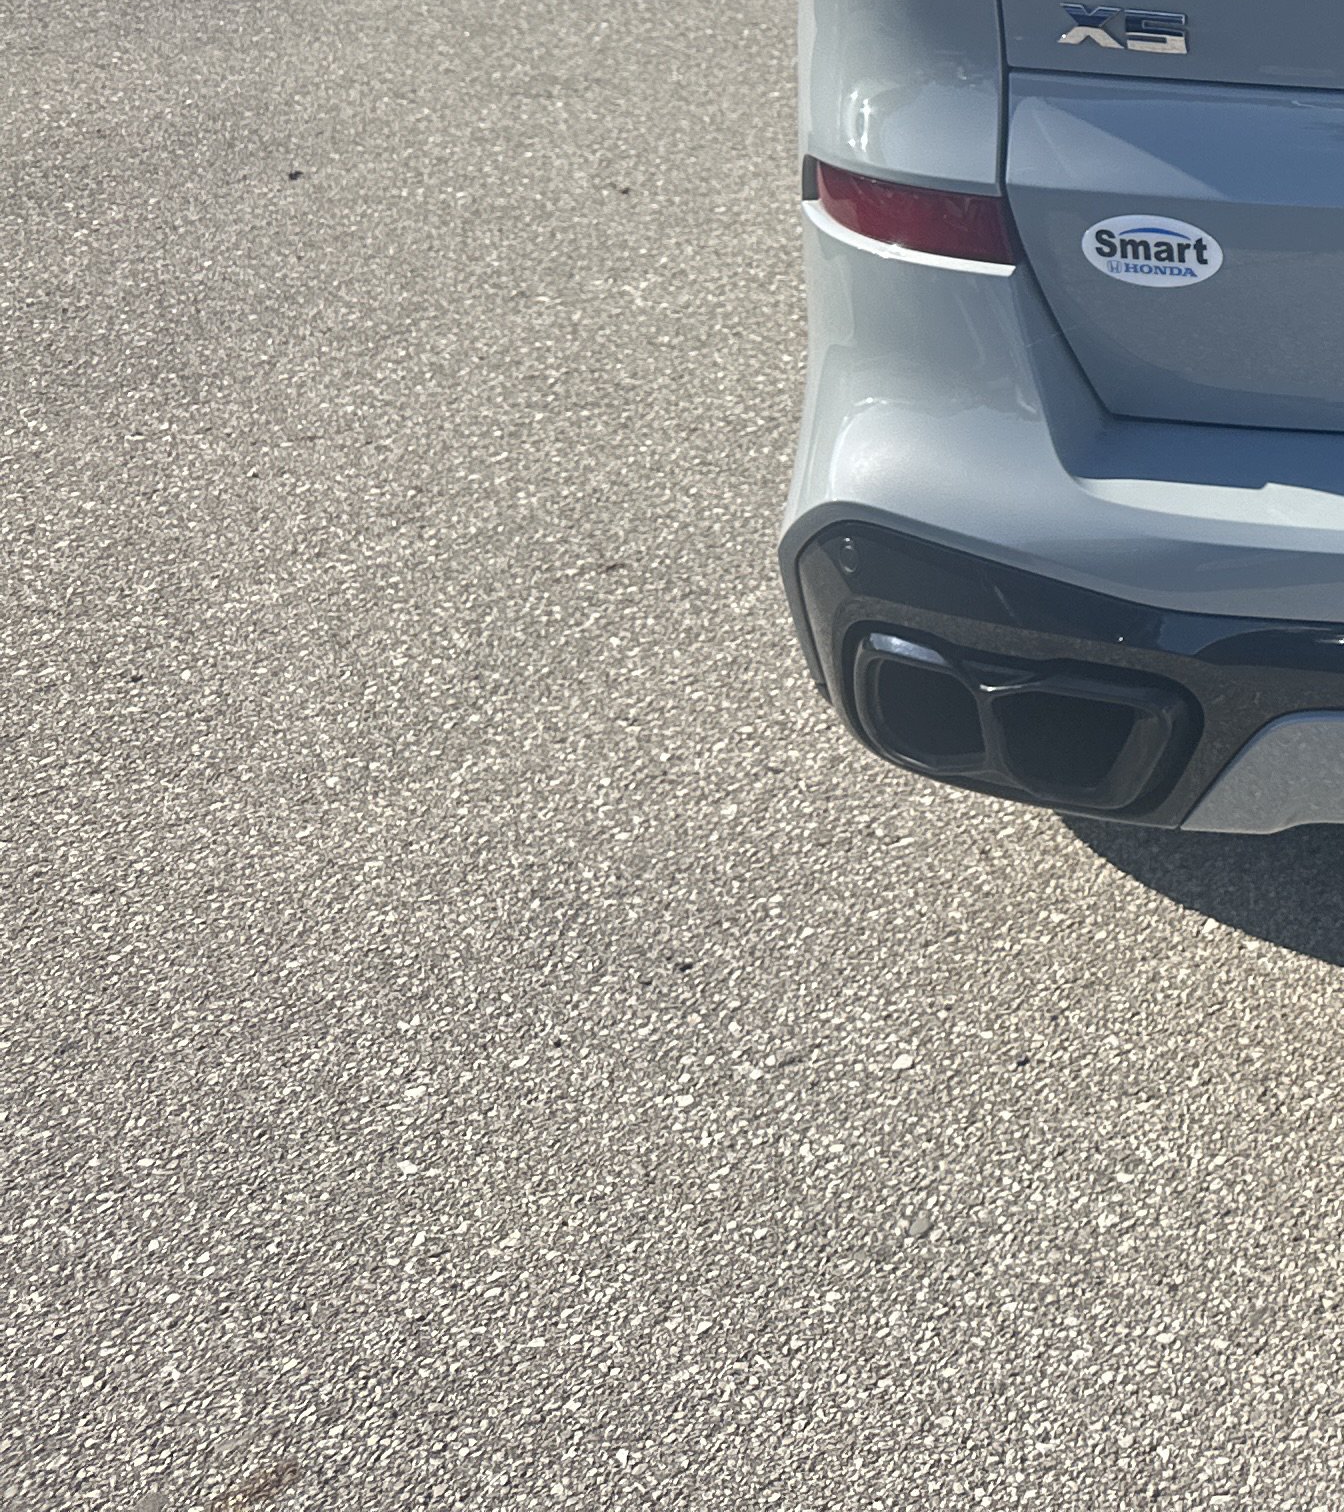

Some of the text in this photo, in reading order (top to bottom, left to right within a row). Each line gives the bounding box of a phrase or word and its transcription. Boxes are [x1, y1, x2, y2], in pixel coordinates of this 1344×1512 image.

[1057, 2, 1188, 55] X5
[1094, 228, 1209, 266] Smart
[1123, 260, 1198, 278] HONDA
